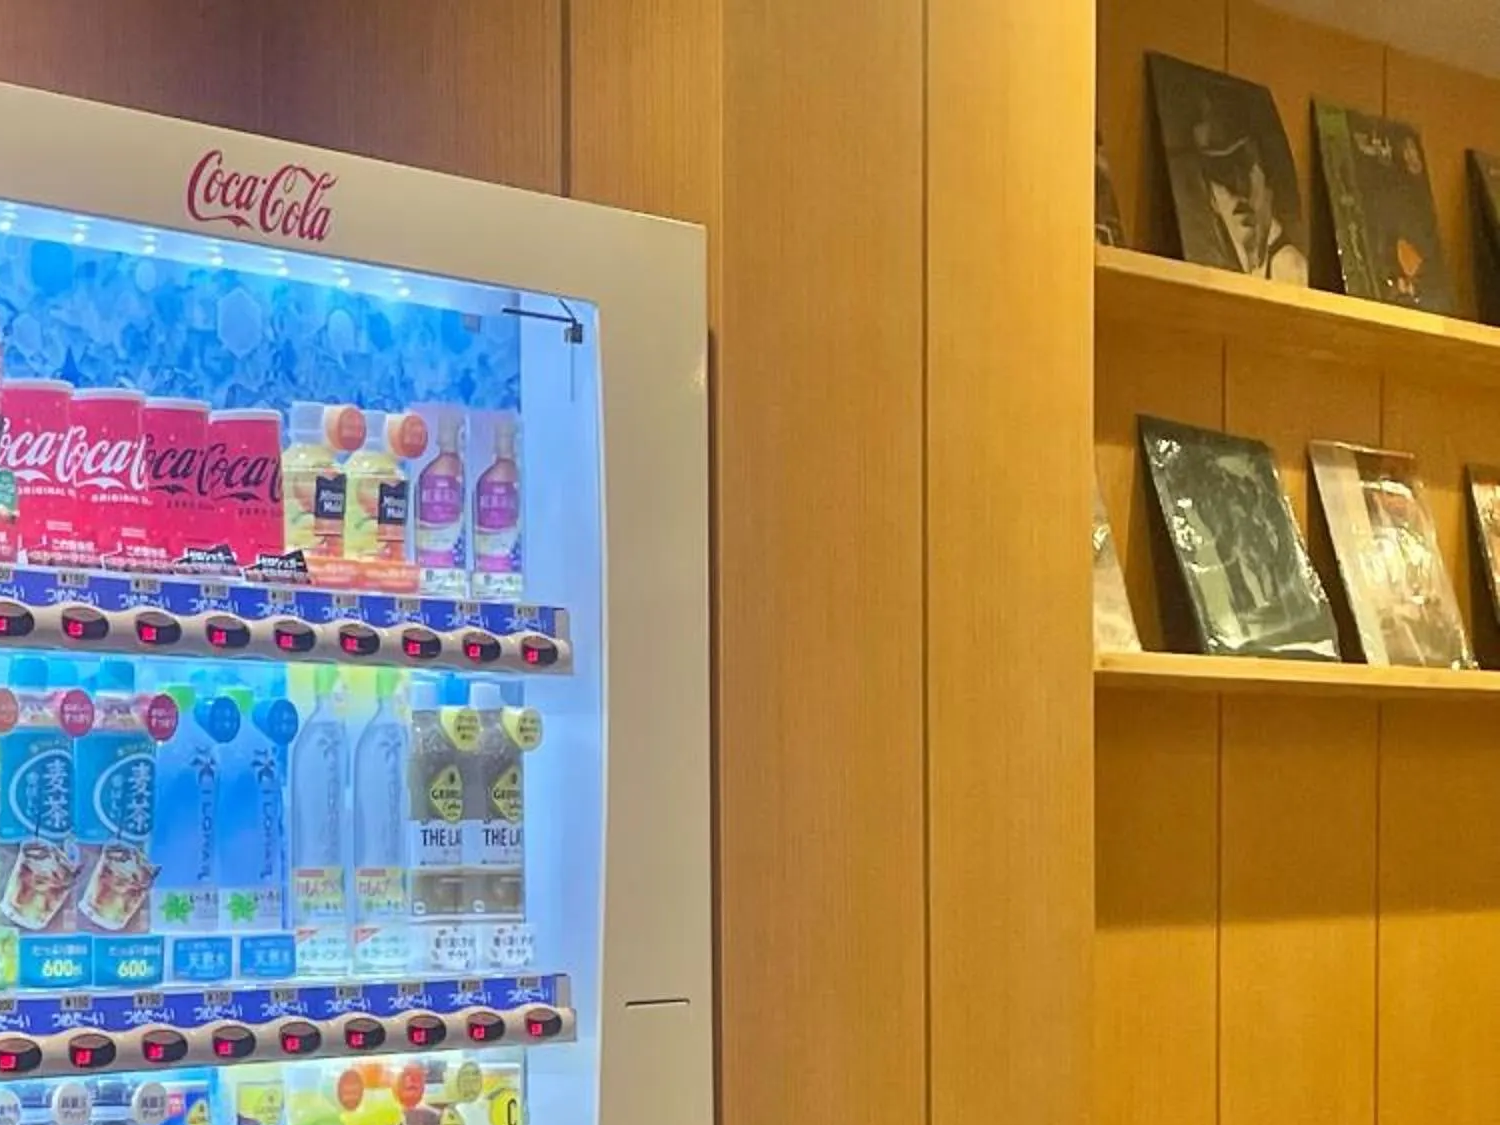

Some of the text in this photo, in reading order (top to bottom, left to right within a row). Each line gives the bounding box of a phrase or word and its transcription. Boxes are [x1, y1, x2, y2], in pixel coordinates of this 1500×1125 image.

[187, 150, 338, 241] Coca-Cola
[420, 828, 449, 846] THE
[483, 828, 507, 846] THE
